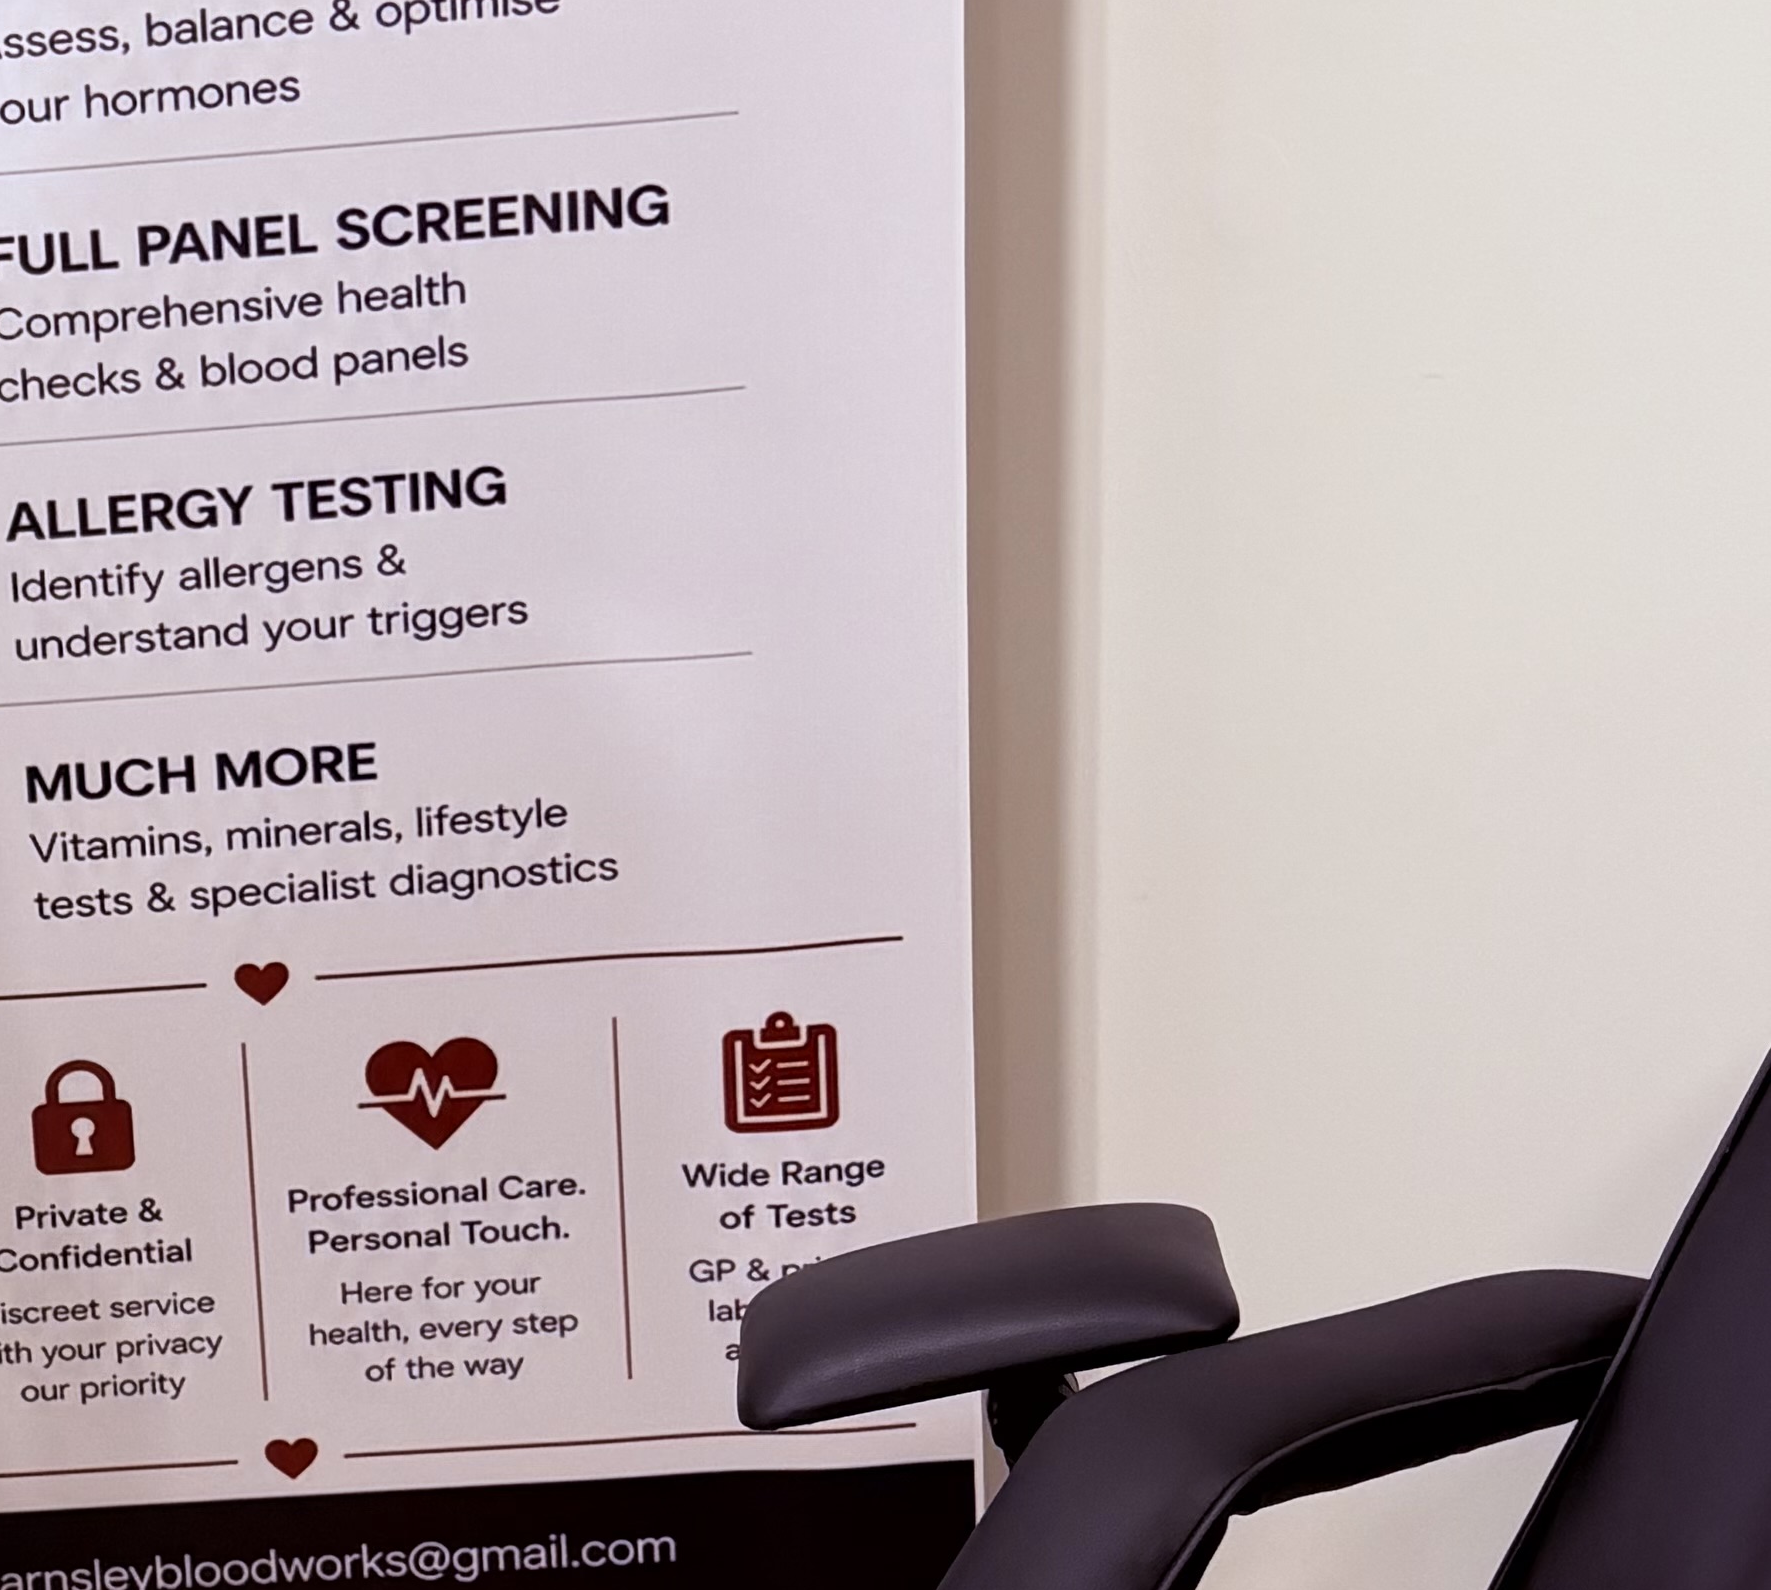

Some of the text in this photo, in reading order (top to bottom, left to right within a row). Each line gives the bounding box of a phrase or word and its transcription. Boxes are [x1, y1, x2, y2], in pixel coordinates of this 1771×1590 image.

[146, 8, 313, 46] balance
[85, 77, 300, 118] hormones
[138, 214, 318, 266] PANEL
[337, 184, 669, 250] SCREENING
[338, 272, 465, 314] health
[156, 357, 185, 390] &
[201, 346, 318, 387] blood
[334, 335, 468, 386] panels
[7, 466, 506, 542] ALLERGY TESTING
[12, 544, 406, 602] Identify allergens &
[16, 601, 528, 661] understand your triggers
[26, 742, 377, 803] MUCH MORE
[29, 798, 567, 862] Vitamins, minerals, lifestyle
[34, 853, 618, 919] tests & specialist diagnostics
[682, 1160, 884, 1187] Wide Range
[16, 1198, 163, 1229] Private &
[288, 1176, 585, 1213] Professional Care.
[309, 1215, 569, 1254] Personal Touch.
[720, 1203, 856, 1229] of Tests
[689, 1259, 736, 1283] GP
[747, 1258, 770, 1281] &
[110, 1292, 215, 1318] service
[341, 1276, 541, 1304] Here for your
[310, 1314, 578, 1346] health, every step
[41, 1342, 106, 1369] your
[116, 1333, 222, 1364] privacy
[365, 1356, 523, 1382] of the way
[21, 1372, 185, 1405] our priority
